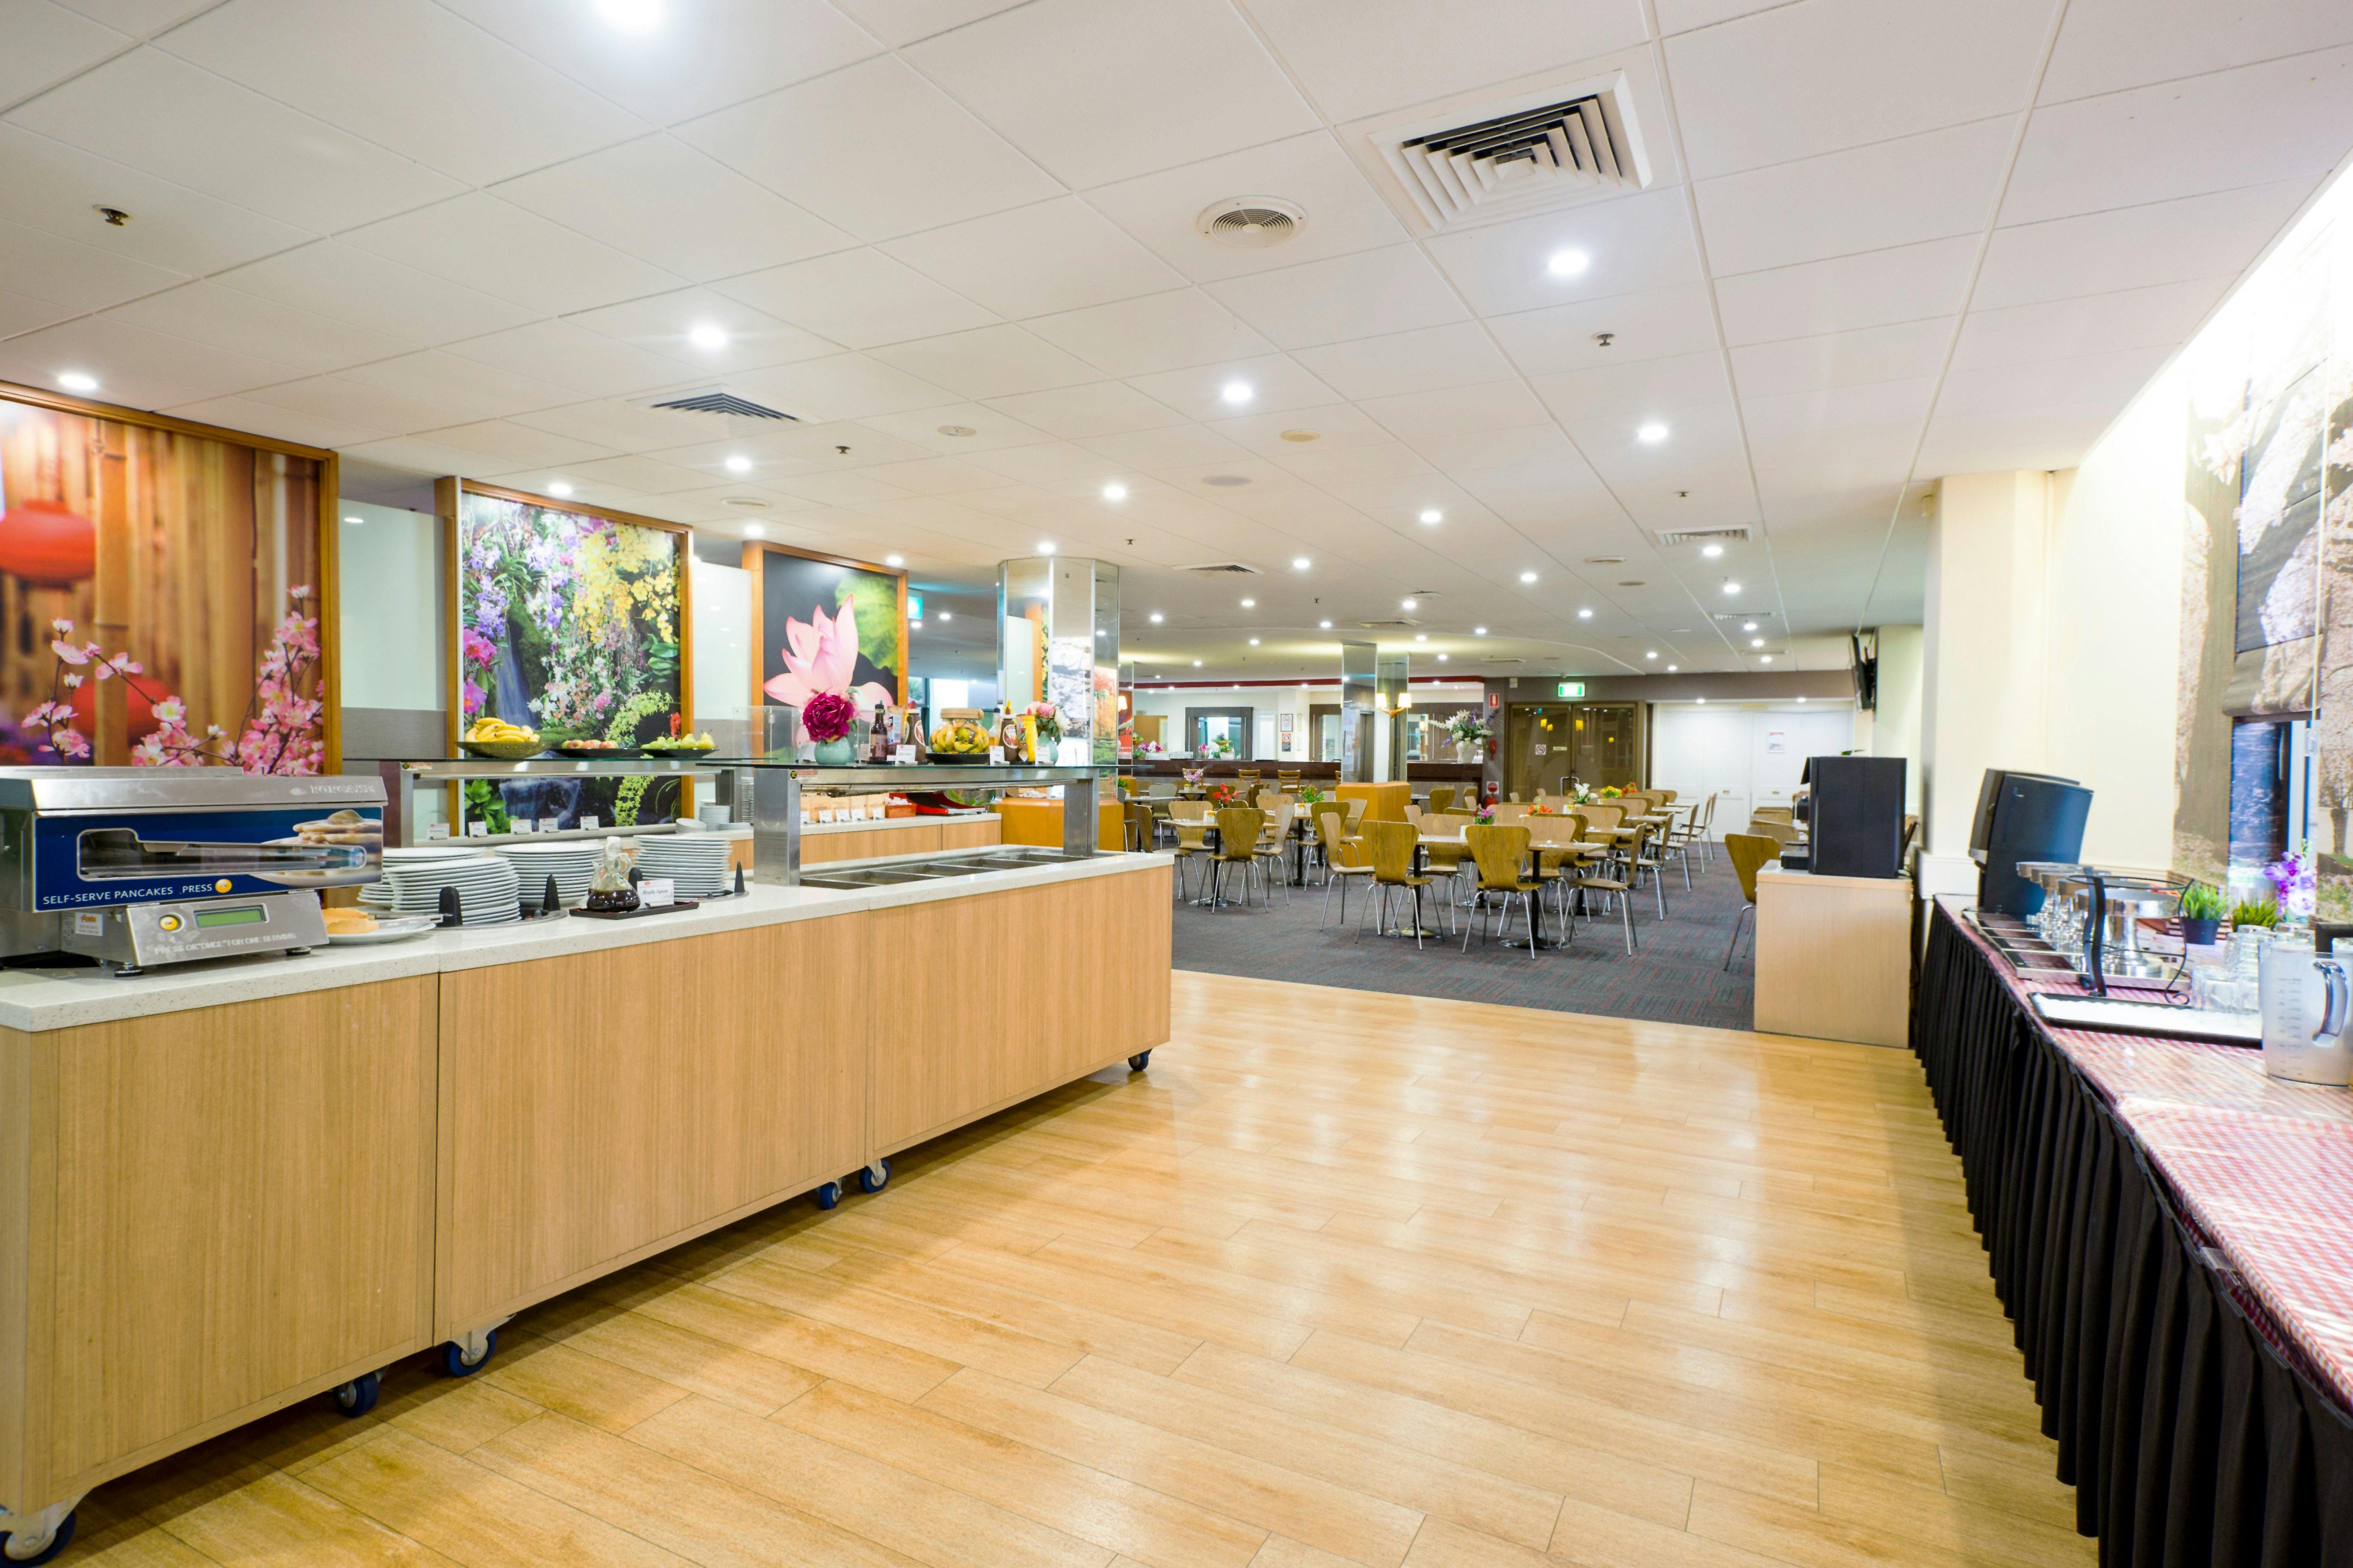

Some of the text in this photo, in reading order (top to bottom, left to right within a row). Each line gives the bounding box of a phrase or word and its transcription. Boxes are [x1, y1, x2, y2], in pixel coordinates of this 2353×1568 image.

[43, 891, 111, 905] SELF-SERVE
[114, 886, 173, 899] PANCAKES
[182, 883, 212, 894] PRESS
